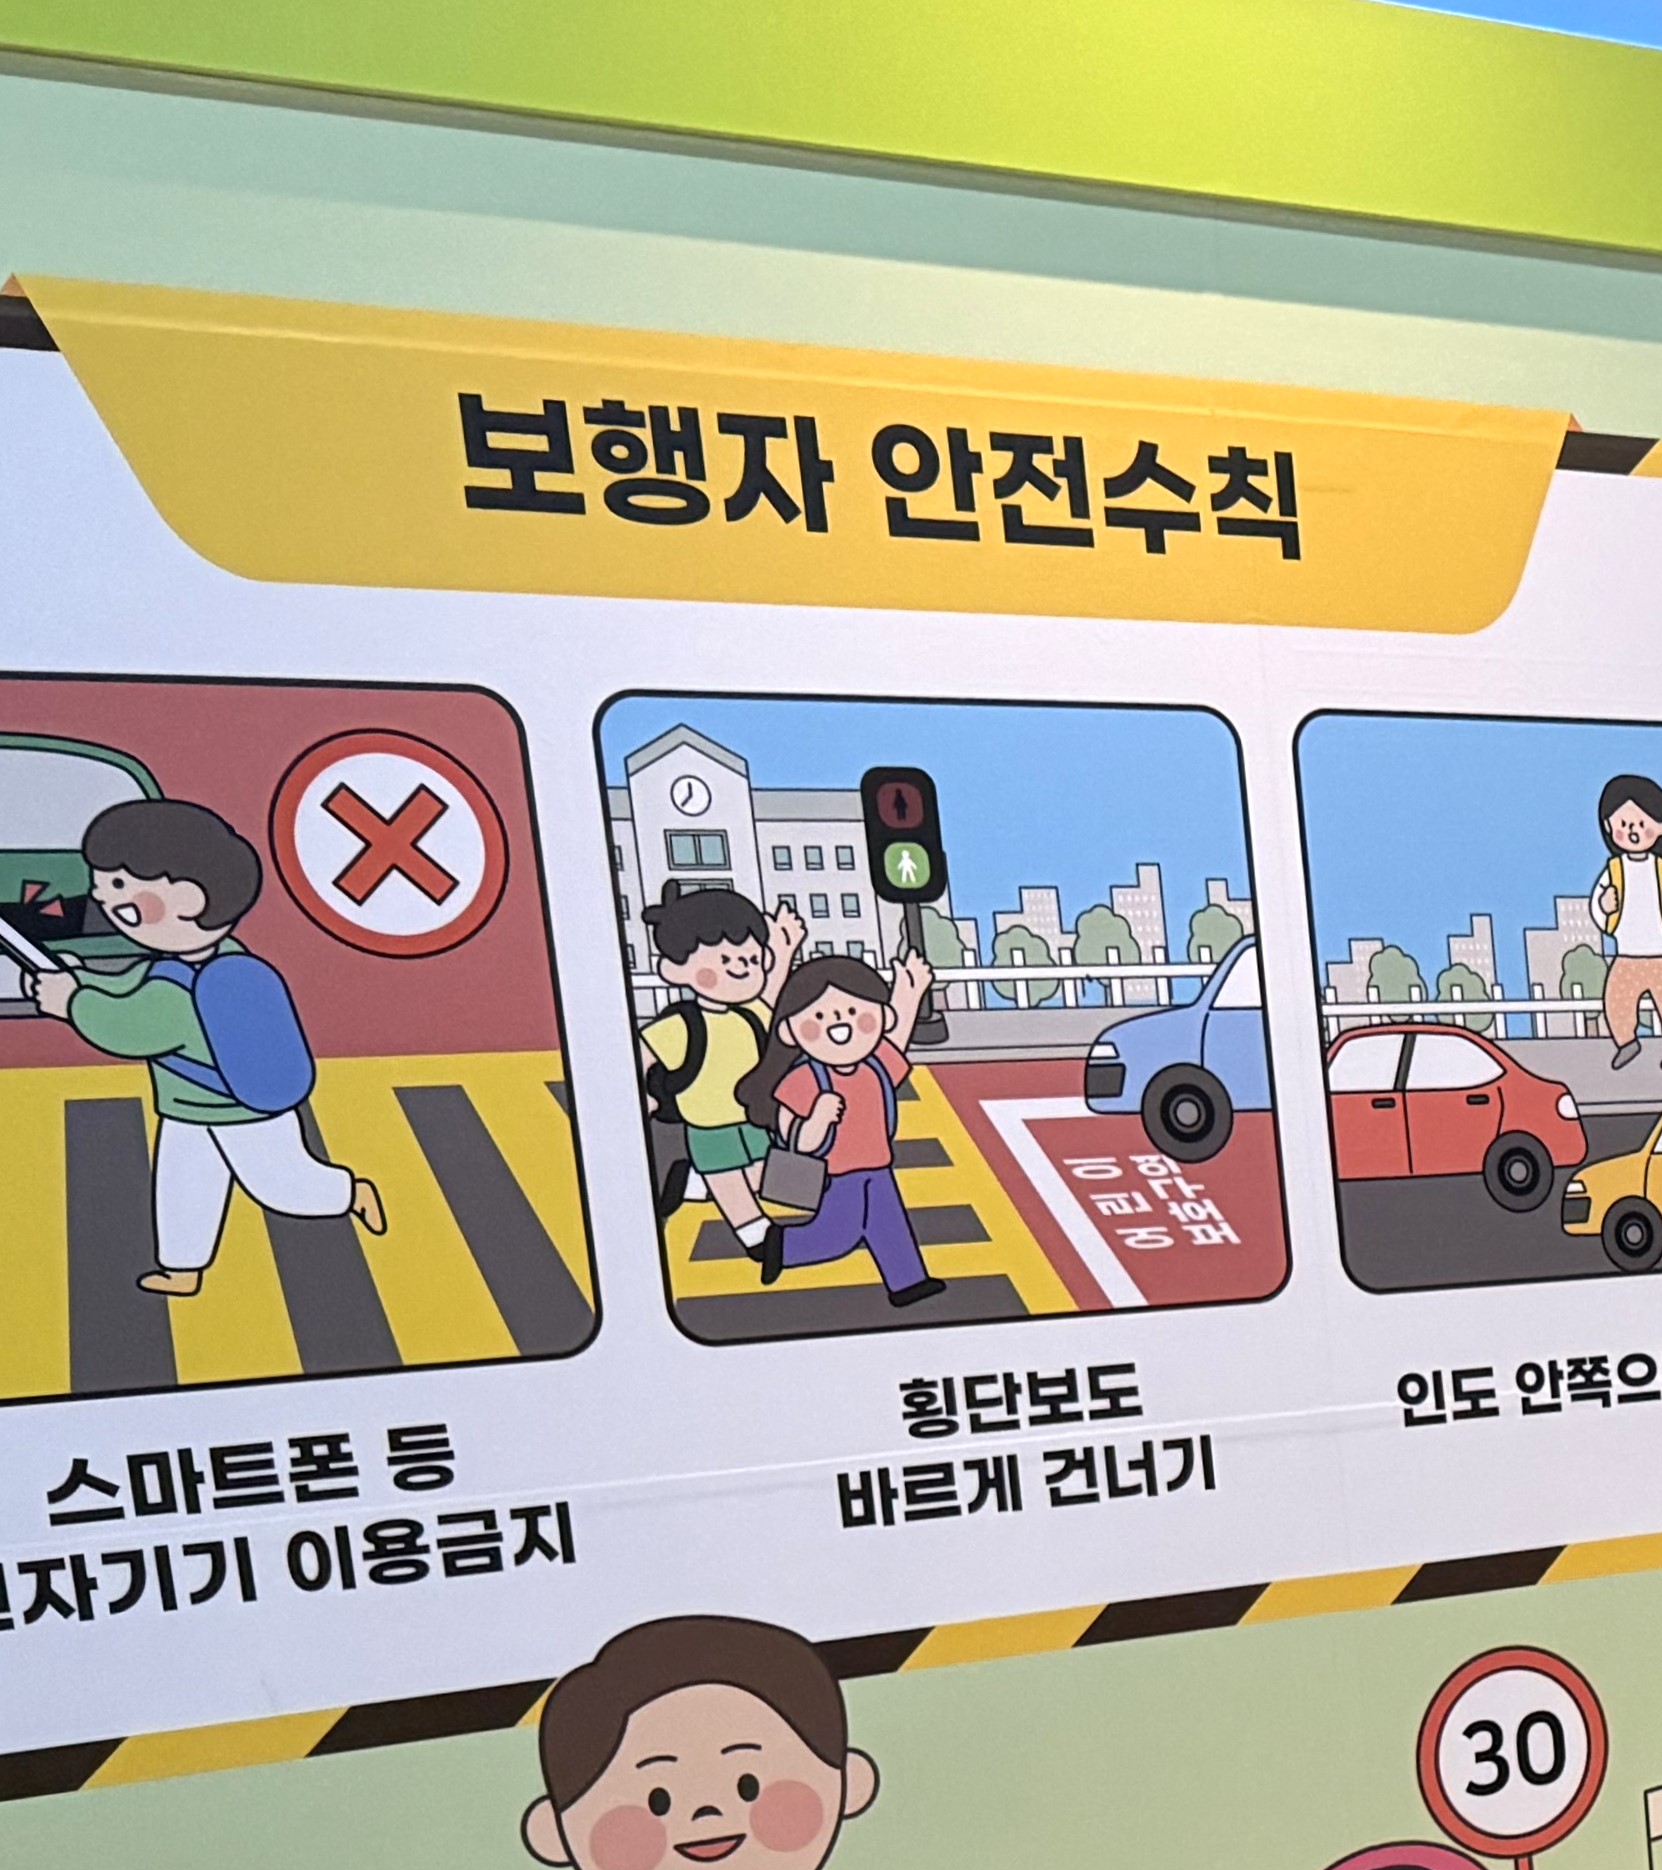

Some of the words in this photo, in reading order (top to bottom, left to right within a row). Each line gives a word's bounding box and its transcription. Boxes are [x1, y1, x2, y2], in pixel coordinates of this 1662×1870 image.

[457, 391, 834, 536] 보행자
[871, 424, 1304, 562] 안전수칙
[899, 1362, 1144, 1440] 횡단보도
[1397, 1366, 1502, 1427] 인도
[45, 1431, 360, 1527] 스마트폰
[387, 1423, 456, 1492] 등
[837, 1451, 1023, 1530] 바르게
[1043, 1434, 1218, 1509] 건너기
[286, 1501, 578, 1593] 이용금지
[1461, 1710, 1567, 1796] 30
